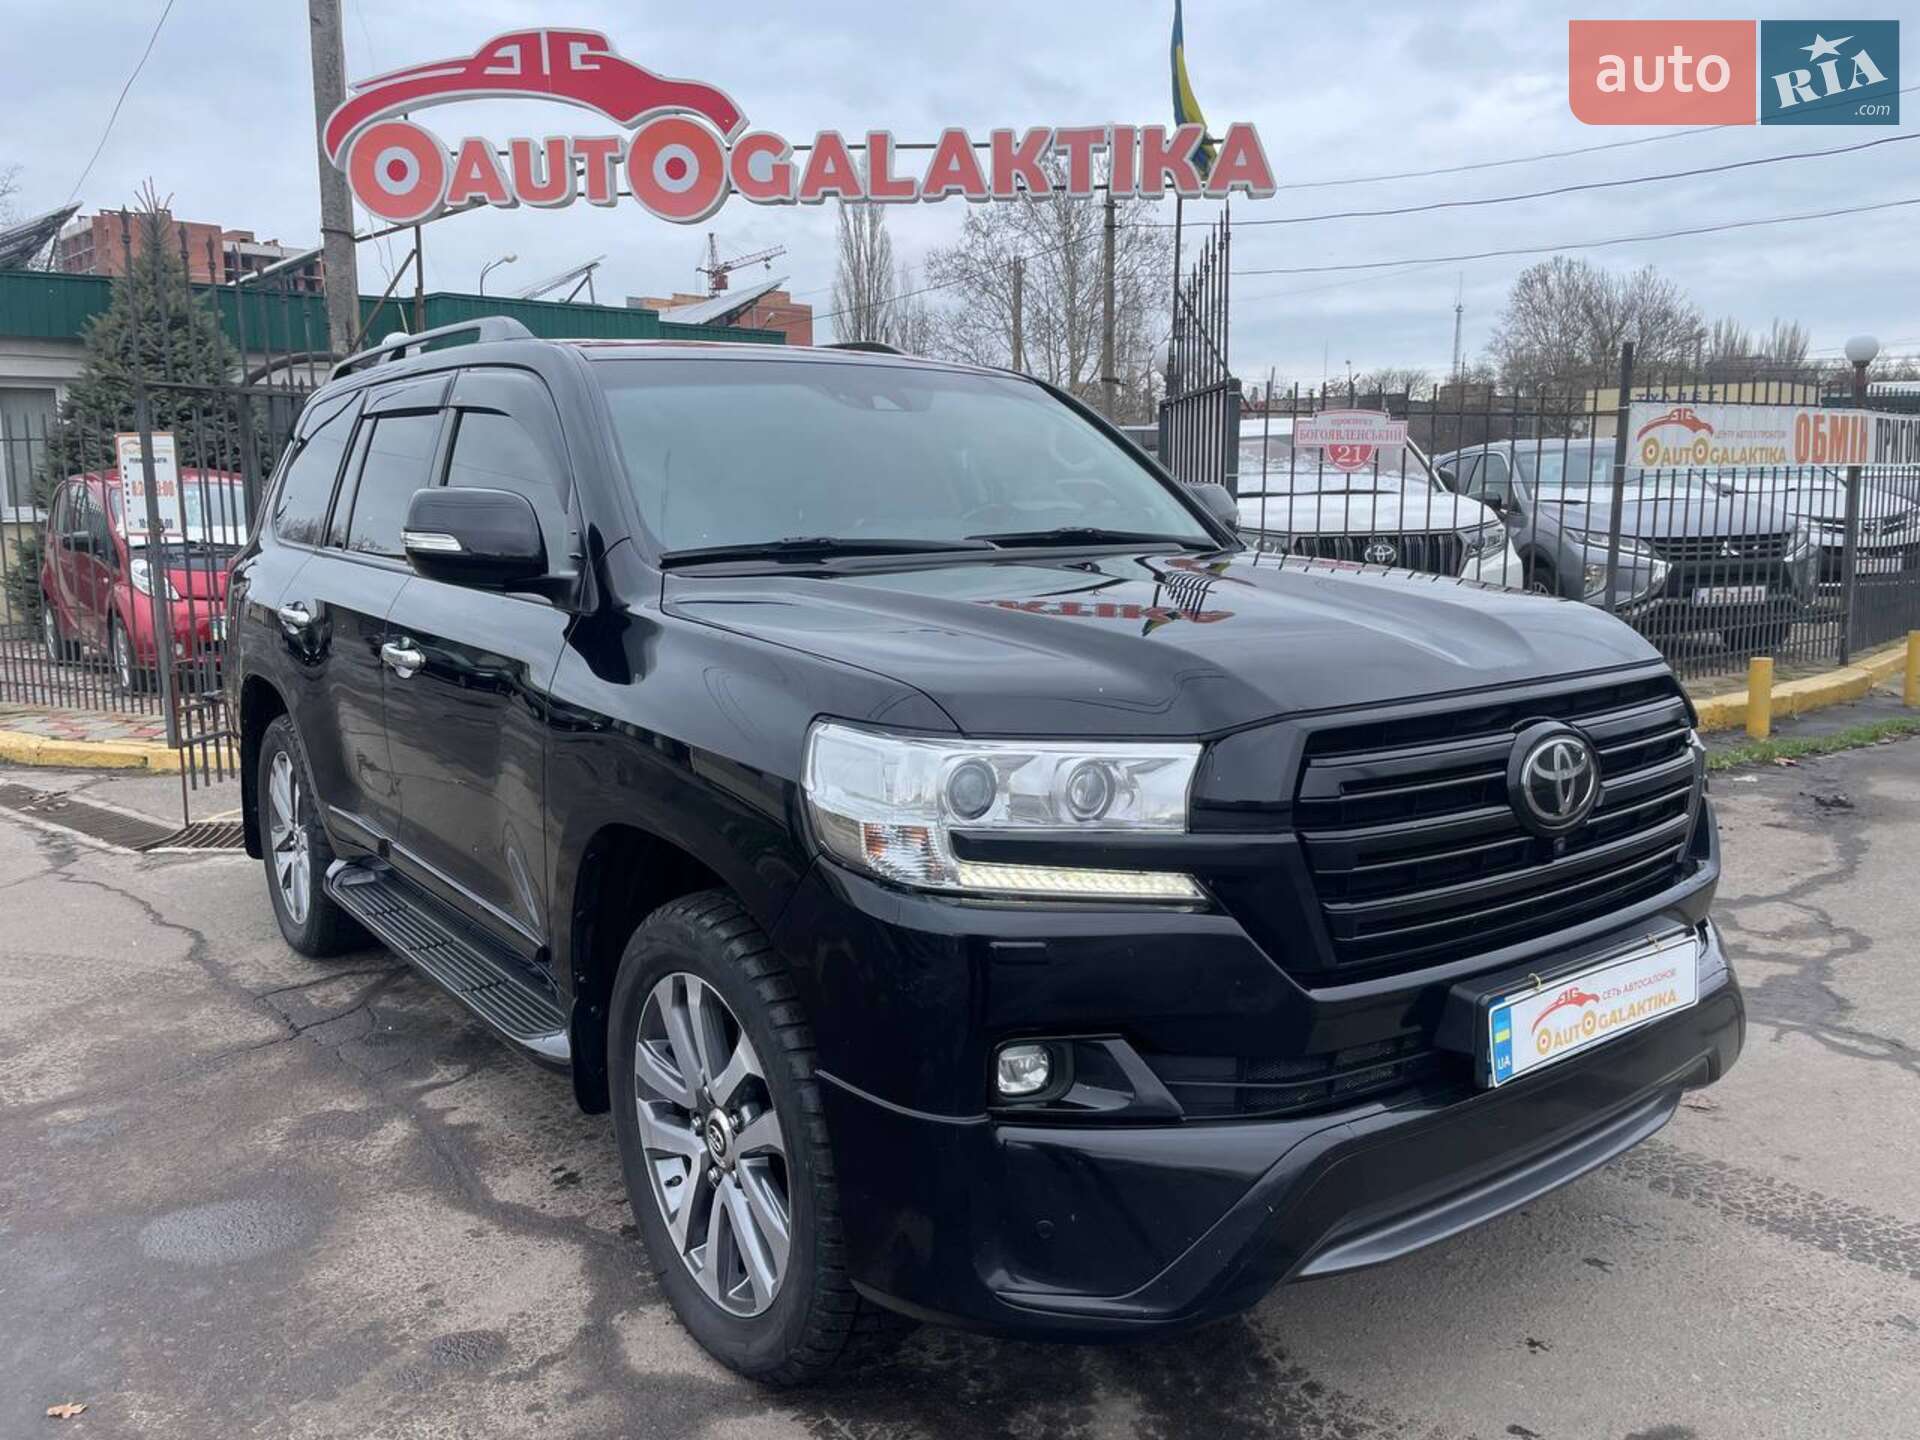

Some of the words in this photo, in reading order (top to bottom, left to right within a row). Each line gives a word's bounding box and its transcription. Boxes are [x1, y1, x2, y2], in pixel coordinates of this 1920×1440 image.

[1794, 413, 1868, 464] ОБМІН
[1338, 445, 1362, 462] 21
[1602, 987, 1622, 1001] СЕТЬ
[1497, 1055, 1512, 1070] UA
